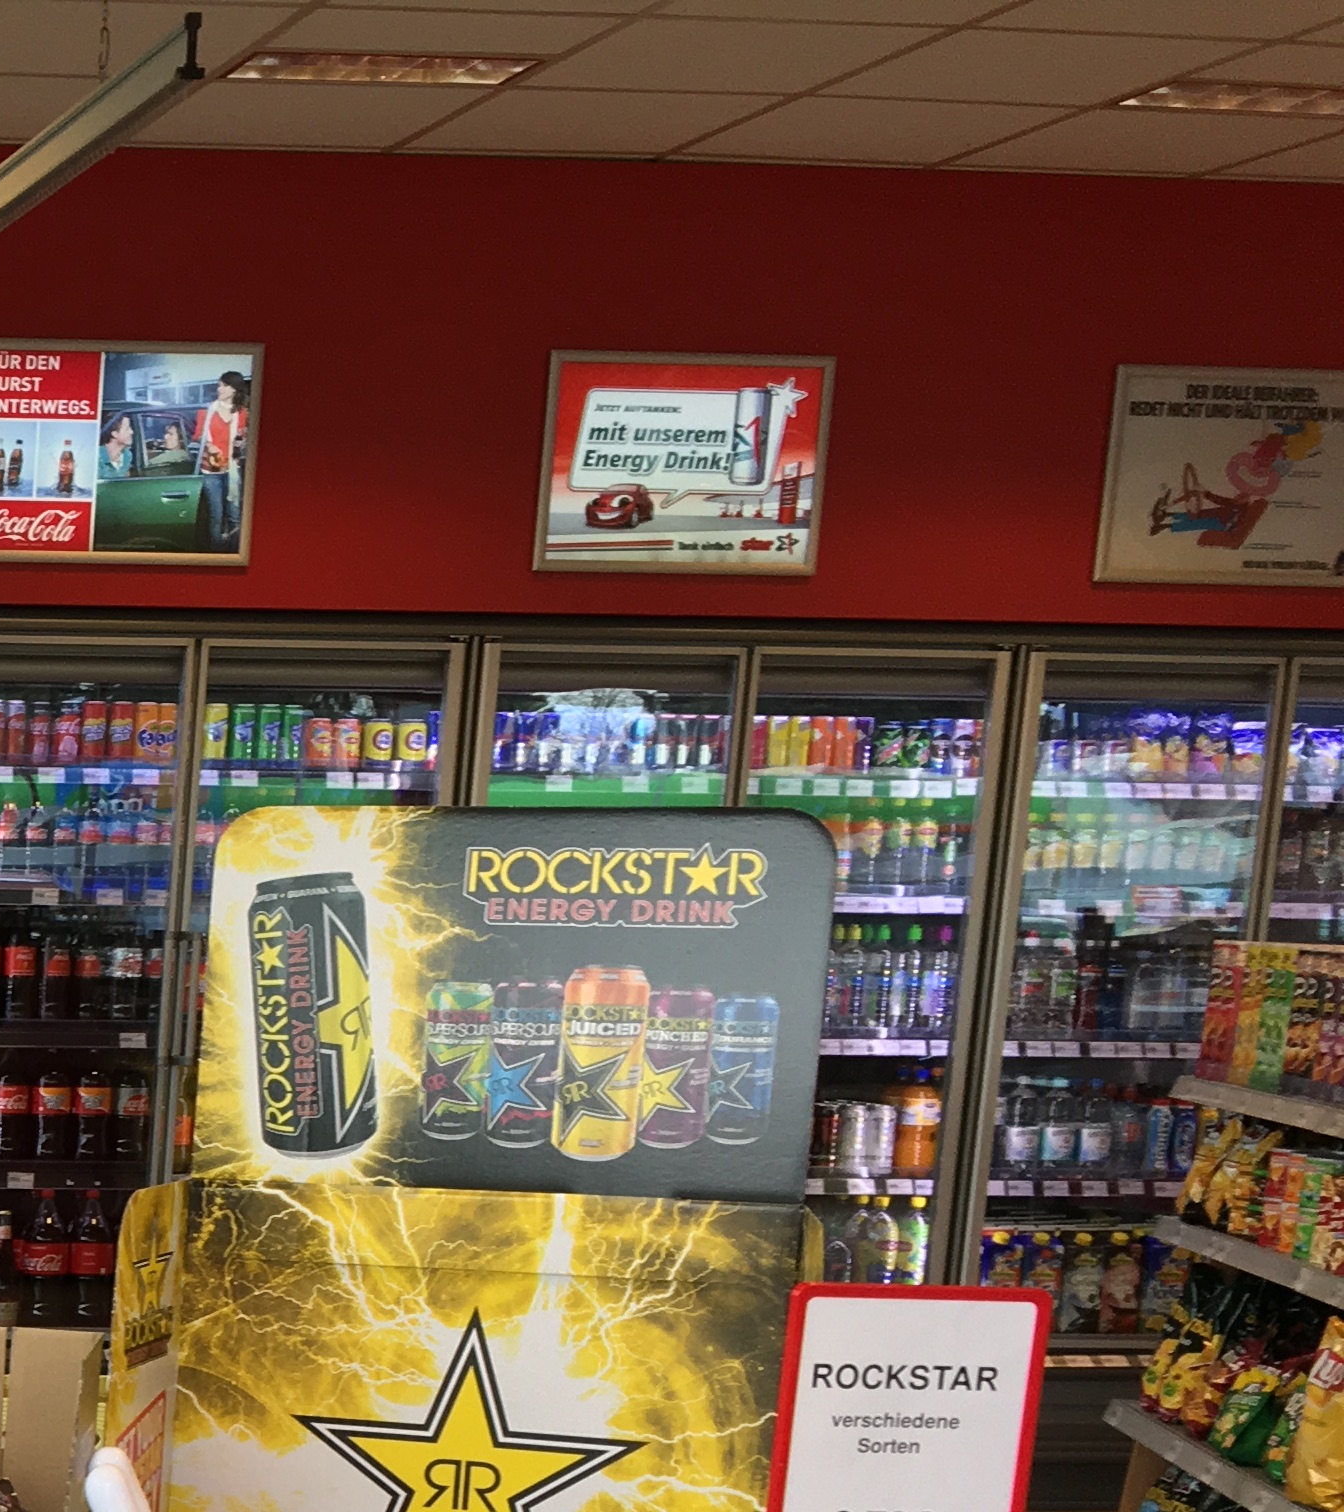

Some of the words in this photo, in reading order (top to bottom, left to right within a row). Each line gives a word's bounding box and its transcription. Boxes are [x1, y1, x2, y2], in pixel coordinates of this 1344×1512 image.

[26, 355, 61, 371] DEN
[588, 421, 627, 442] mit
[633, 425, 727, 444] unserem
[582, 449, 659, 472] Energy
[664, 450, 732, 471] Drink!
[486, 898, 618, 923] ENERGY
[630, 899, 736, 923] DRINK
[285, 927, 314, 1009] DRINK
[566, 1021, 642, 1037] JUICED
[291, 1019, 319, 1118] ENERGY
[812, 1363, 999, 1392] ROCKSTAR
[832, 1413, 961, 1430] verschiedene
[857, 1437, 921, 1455] Sorten
